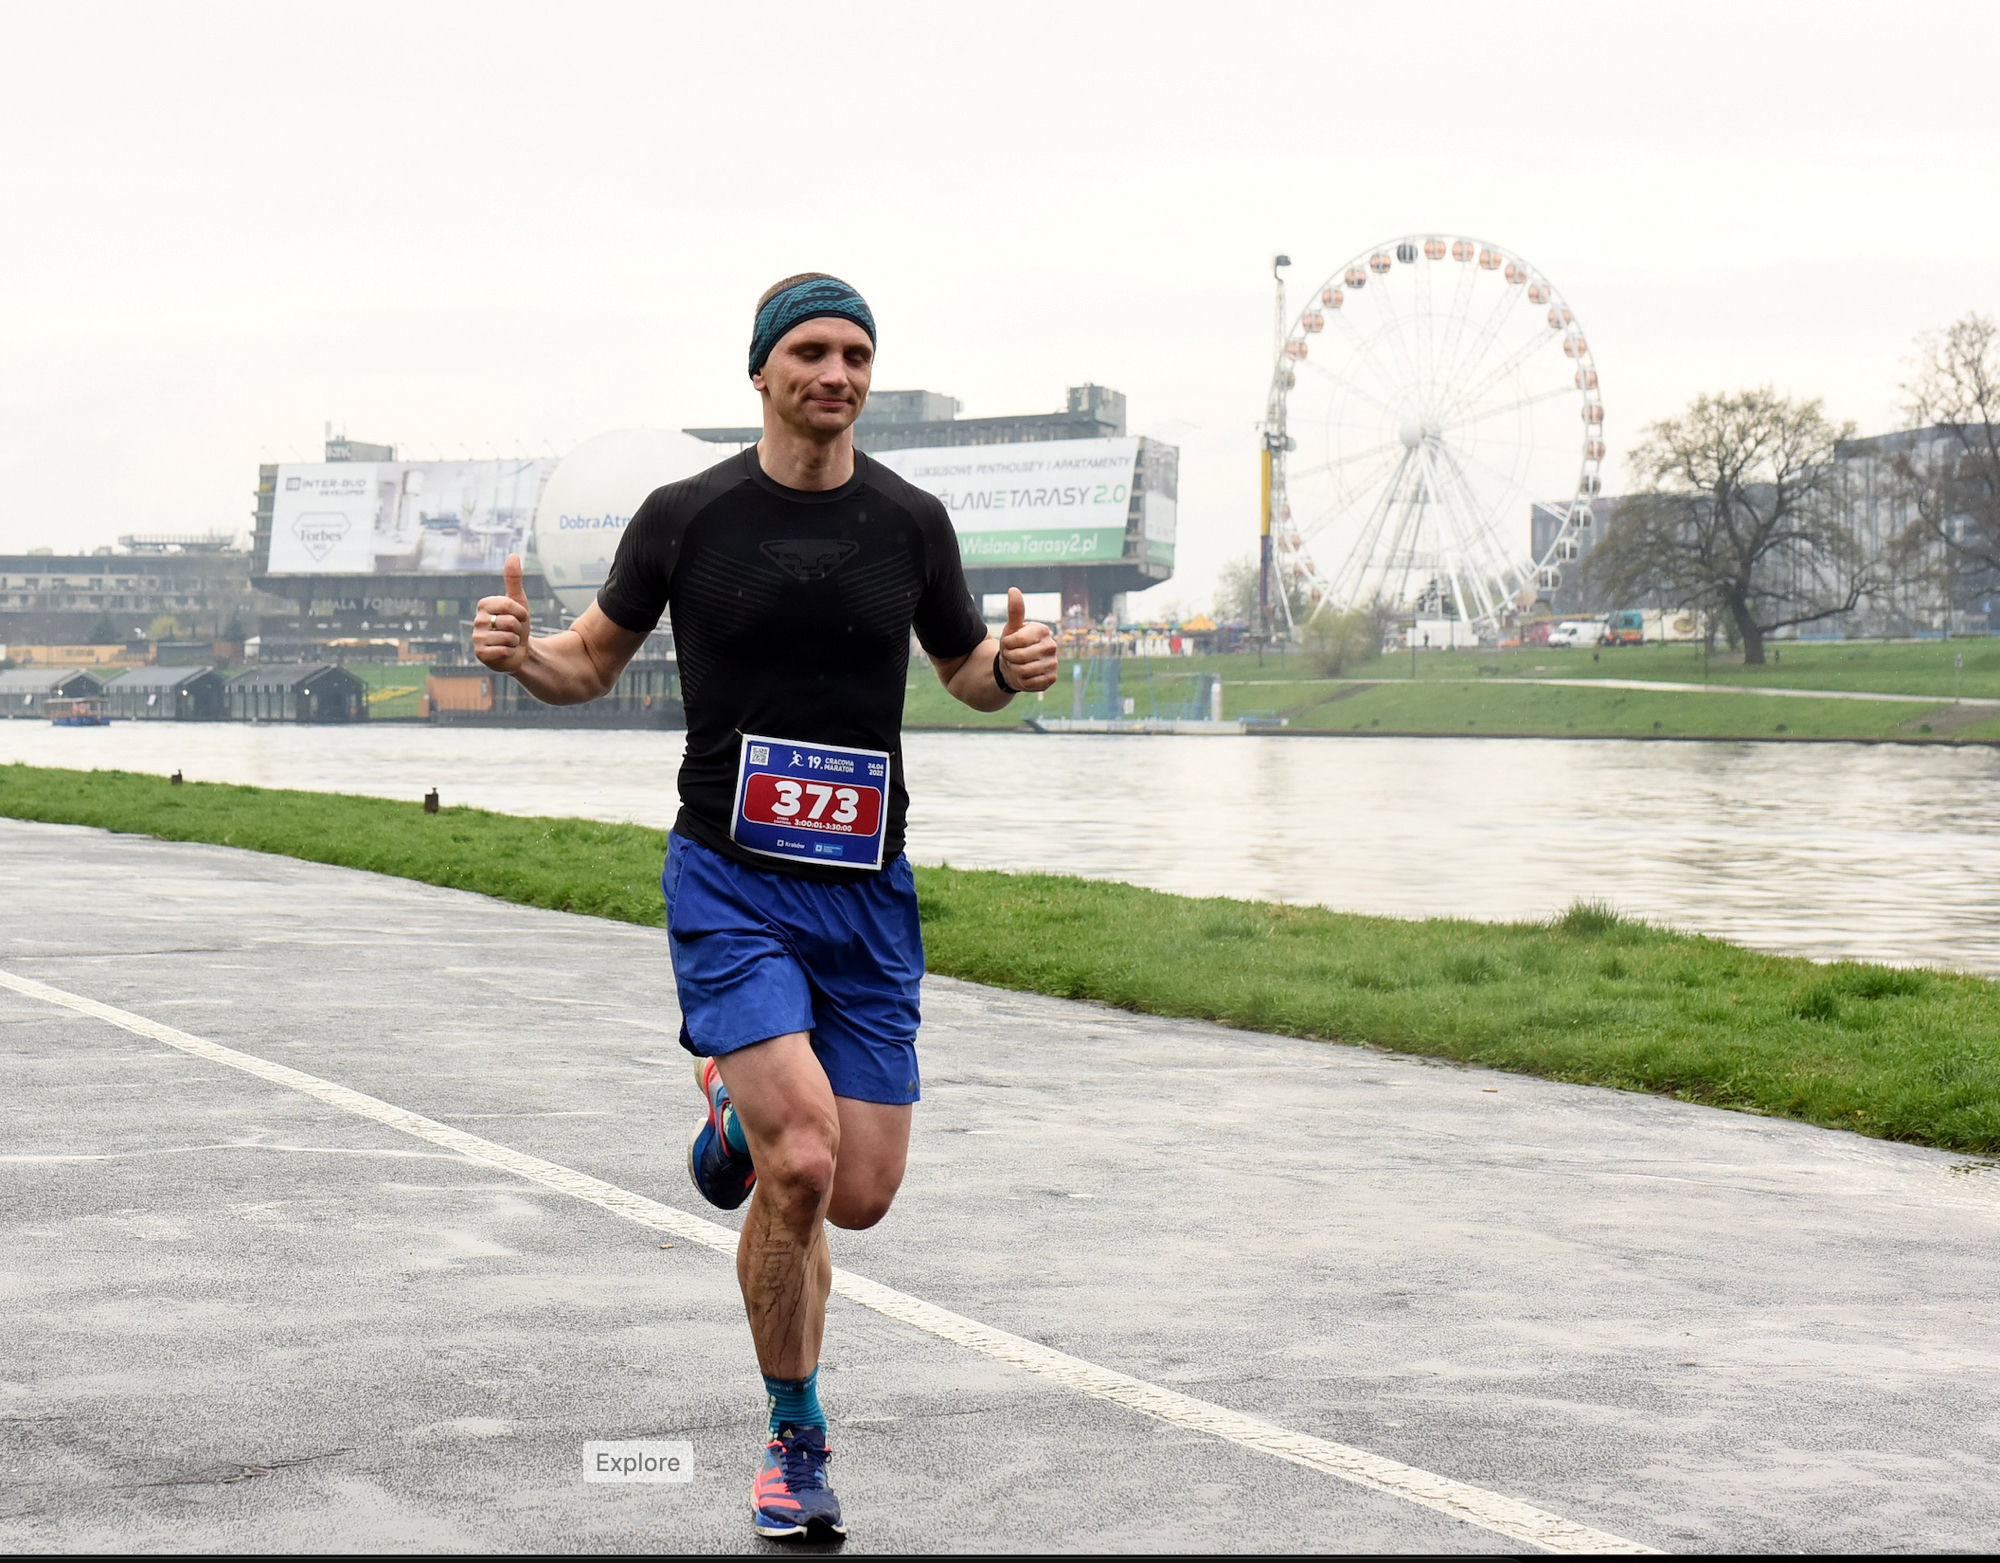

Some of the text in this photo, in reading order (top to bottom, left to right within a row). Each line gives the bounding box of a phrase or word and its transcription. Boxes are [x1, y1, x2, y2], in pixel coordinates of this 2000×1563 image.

[1053, 456, 1131, 470] APARTAMENTY
[1093, 484, 1126, 504] 2.0
[301, 530, 342, 541] Forbes
[807, 755, 854, 770] 19. CRACOVIA
[824, 763, 854, 774] MARATON
[869, 769, 884, 777] 2022
[771, 781, 859, 823] 373
